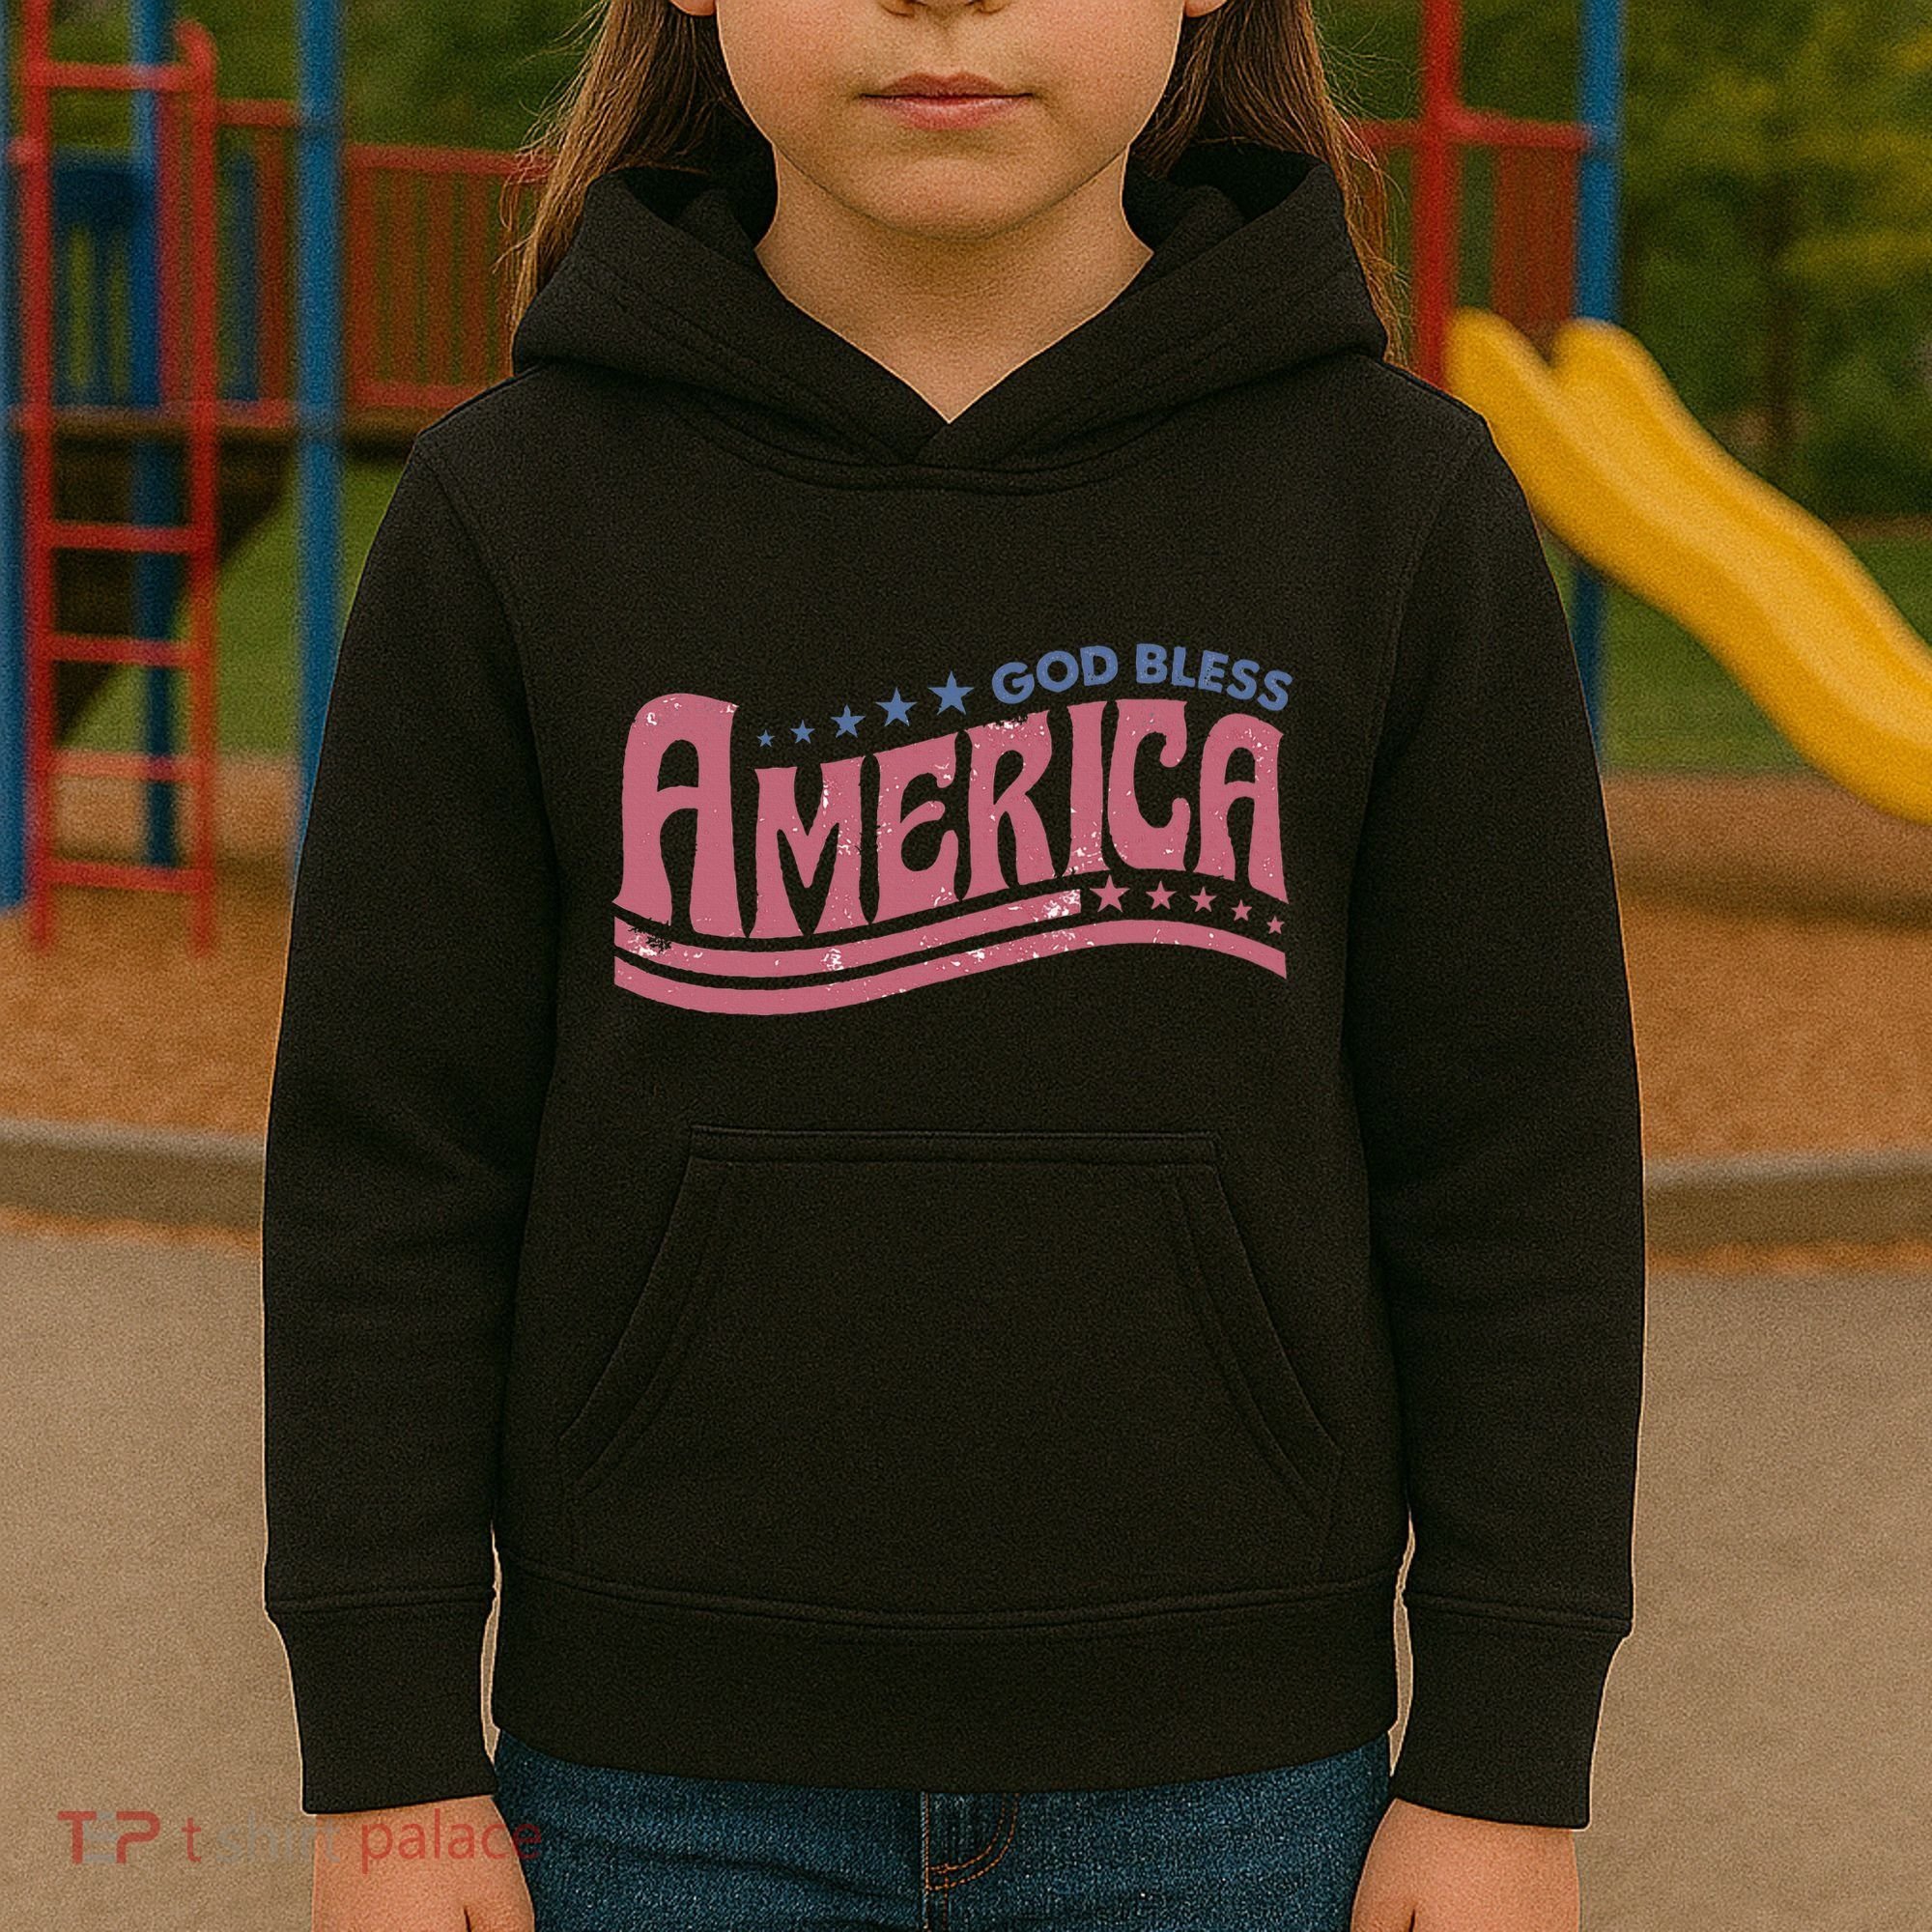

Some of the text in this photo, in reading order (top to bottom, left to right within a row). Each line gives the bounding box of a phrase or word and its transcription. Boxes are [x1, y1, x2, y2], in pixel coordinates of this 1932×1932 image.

[991, 643, 1293, 711] GOD BLESS
[611, 693, 1289, 939] AMERICA
